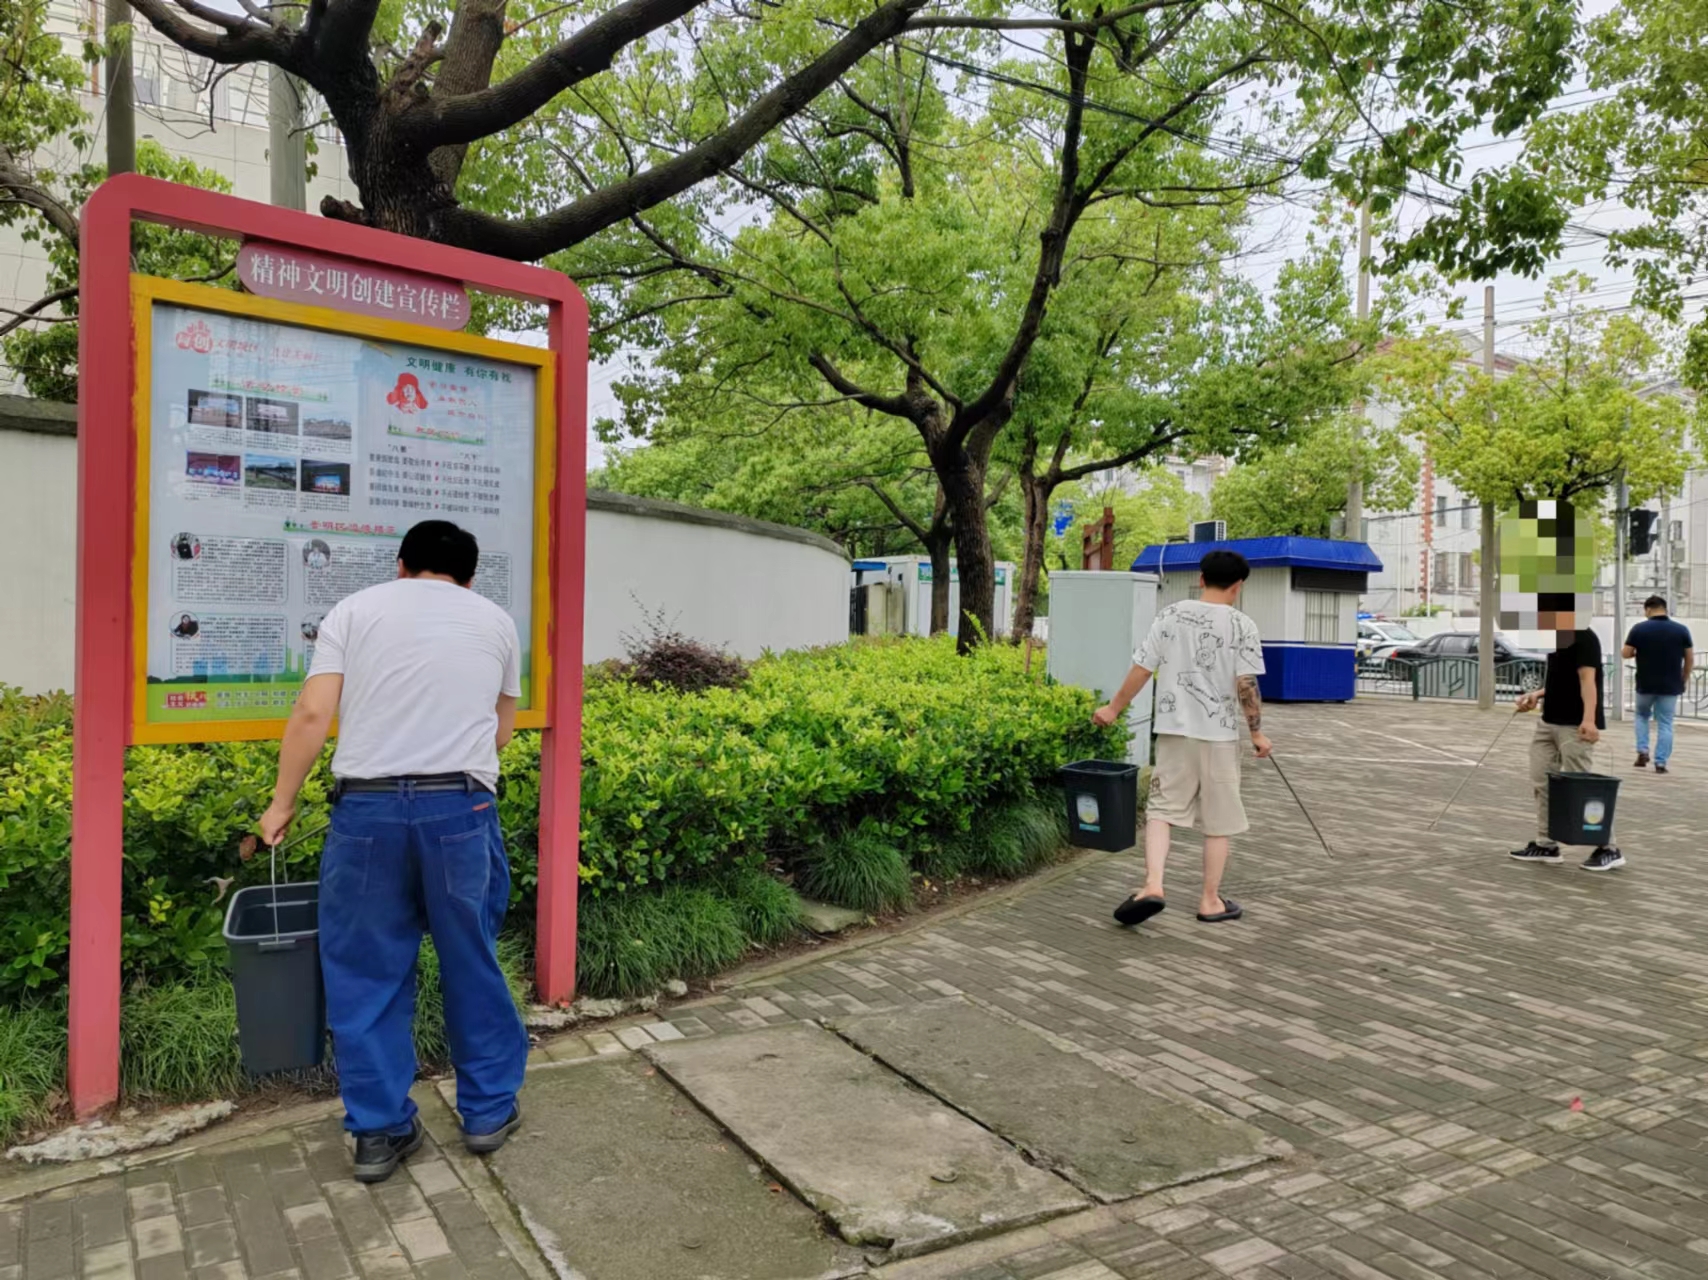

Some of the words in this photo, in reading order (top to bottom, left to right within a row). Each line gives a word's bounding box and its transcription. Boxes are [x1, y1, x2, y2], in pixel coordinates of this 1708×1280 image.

[251, 253, 460, 320] 精神文明创建宣传栏
[406, 356, 456, 373] 文明健康
